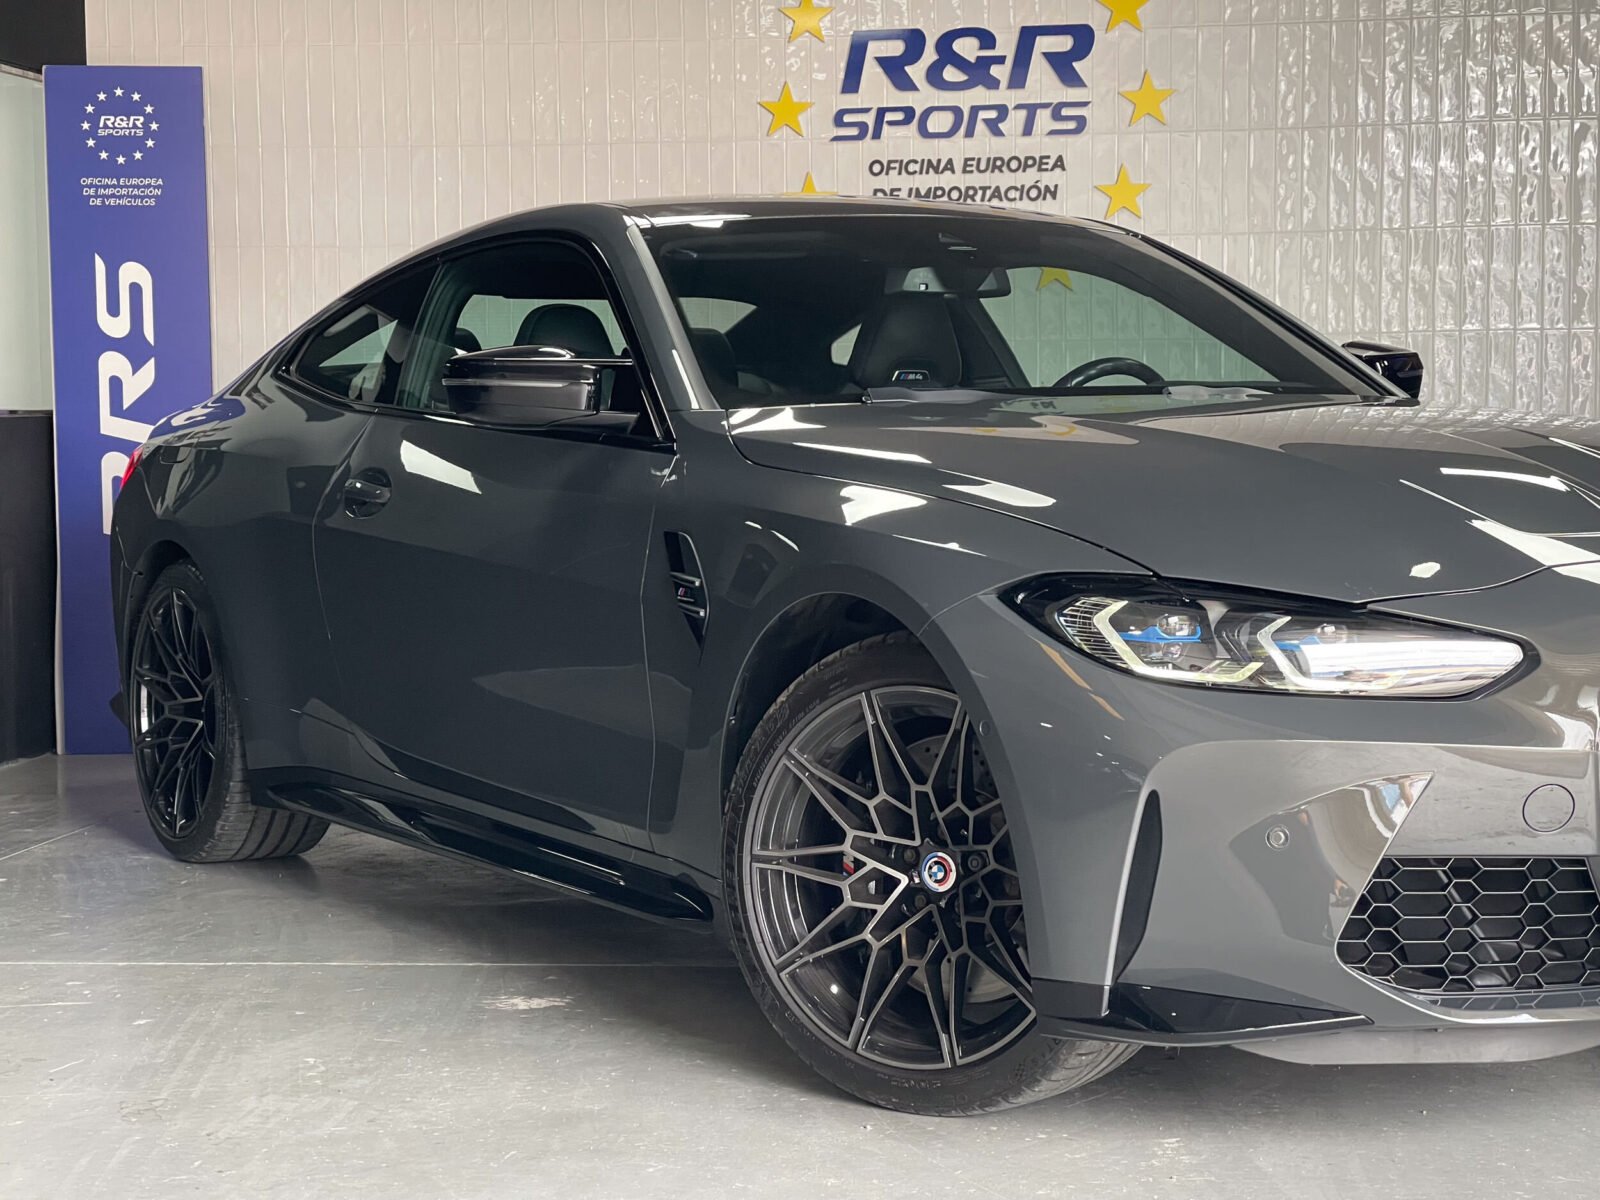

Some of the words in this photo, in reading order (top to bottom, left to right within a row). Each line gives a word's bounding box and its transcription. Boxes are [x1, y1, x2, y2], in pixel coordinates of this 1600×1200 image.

[841, 24, 1095, 93] R&R
[99, 115, 144, 128] R&R
[830, 101, 1091, 142] SPORTS
[97, 128, 144, 137] SPORTS
[868, 157, 956, 177] OFICINA
[962, 154, 1066, 174] EUROPEA
[80, 177, 118, 186] OFICINA
[119, 177, 164, 186] EUROPEA
[82, 187, 97, 196] DE
[98, 186, 162, 196] IMPORTACIÓN
[907, 179, 1059, 203] IMPORTACIÓN
[89, 197, 102, 206] DE
[104, 196, 156, 206] VEHÍCULOS
